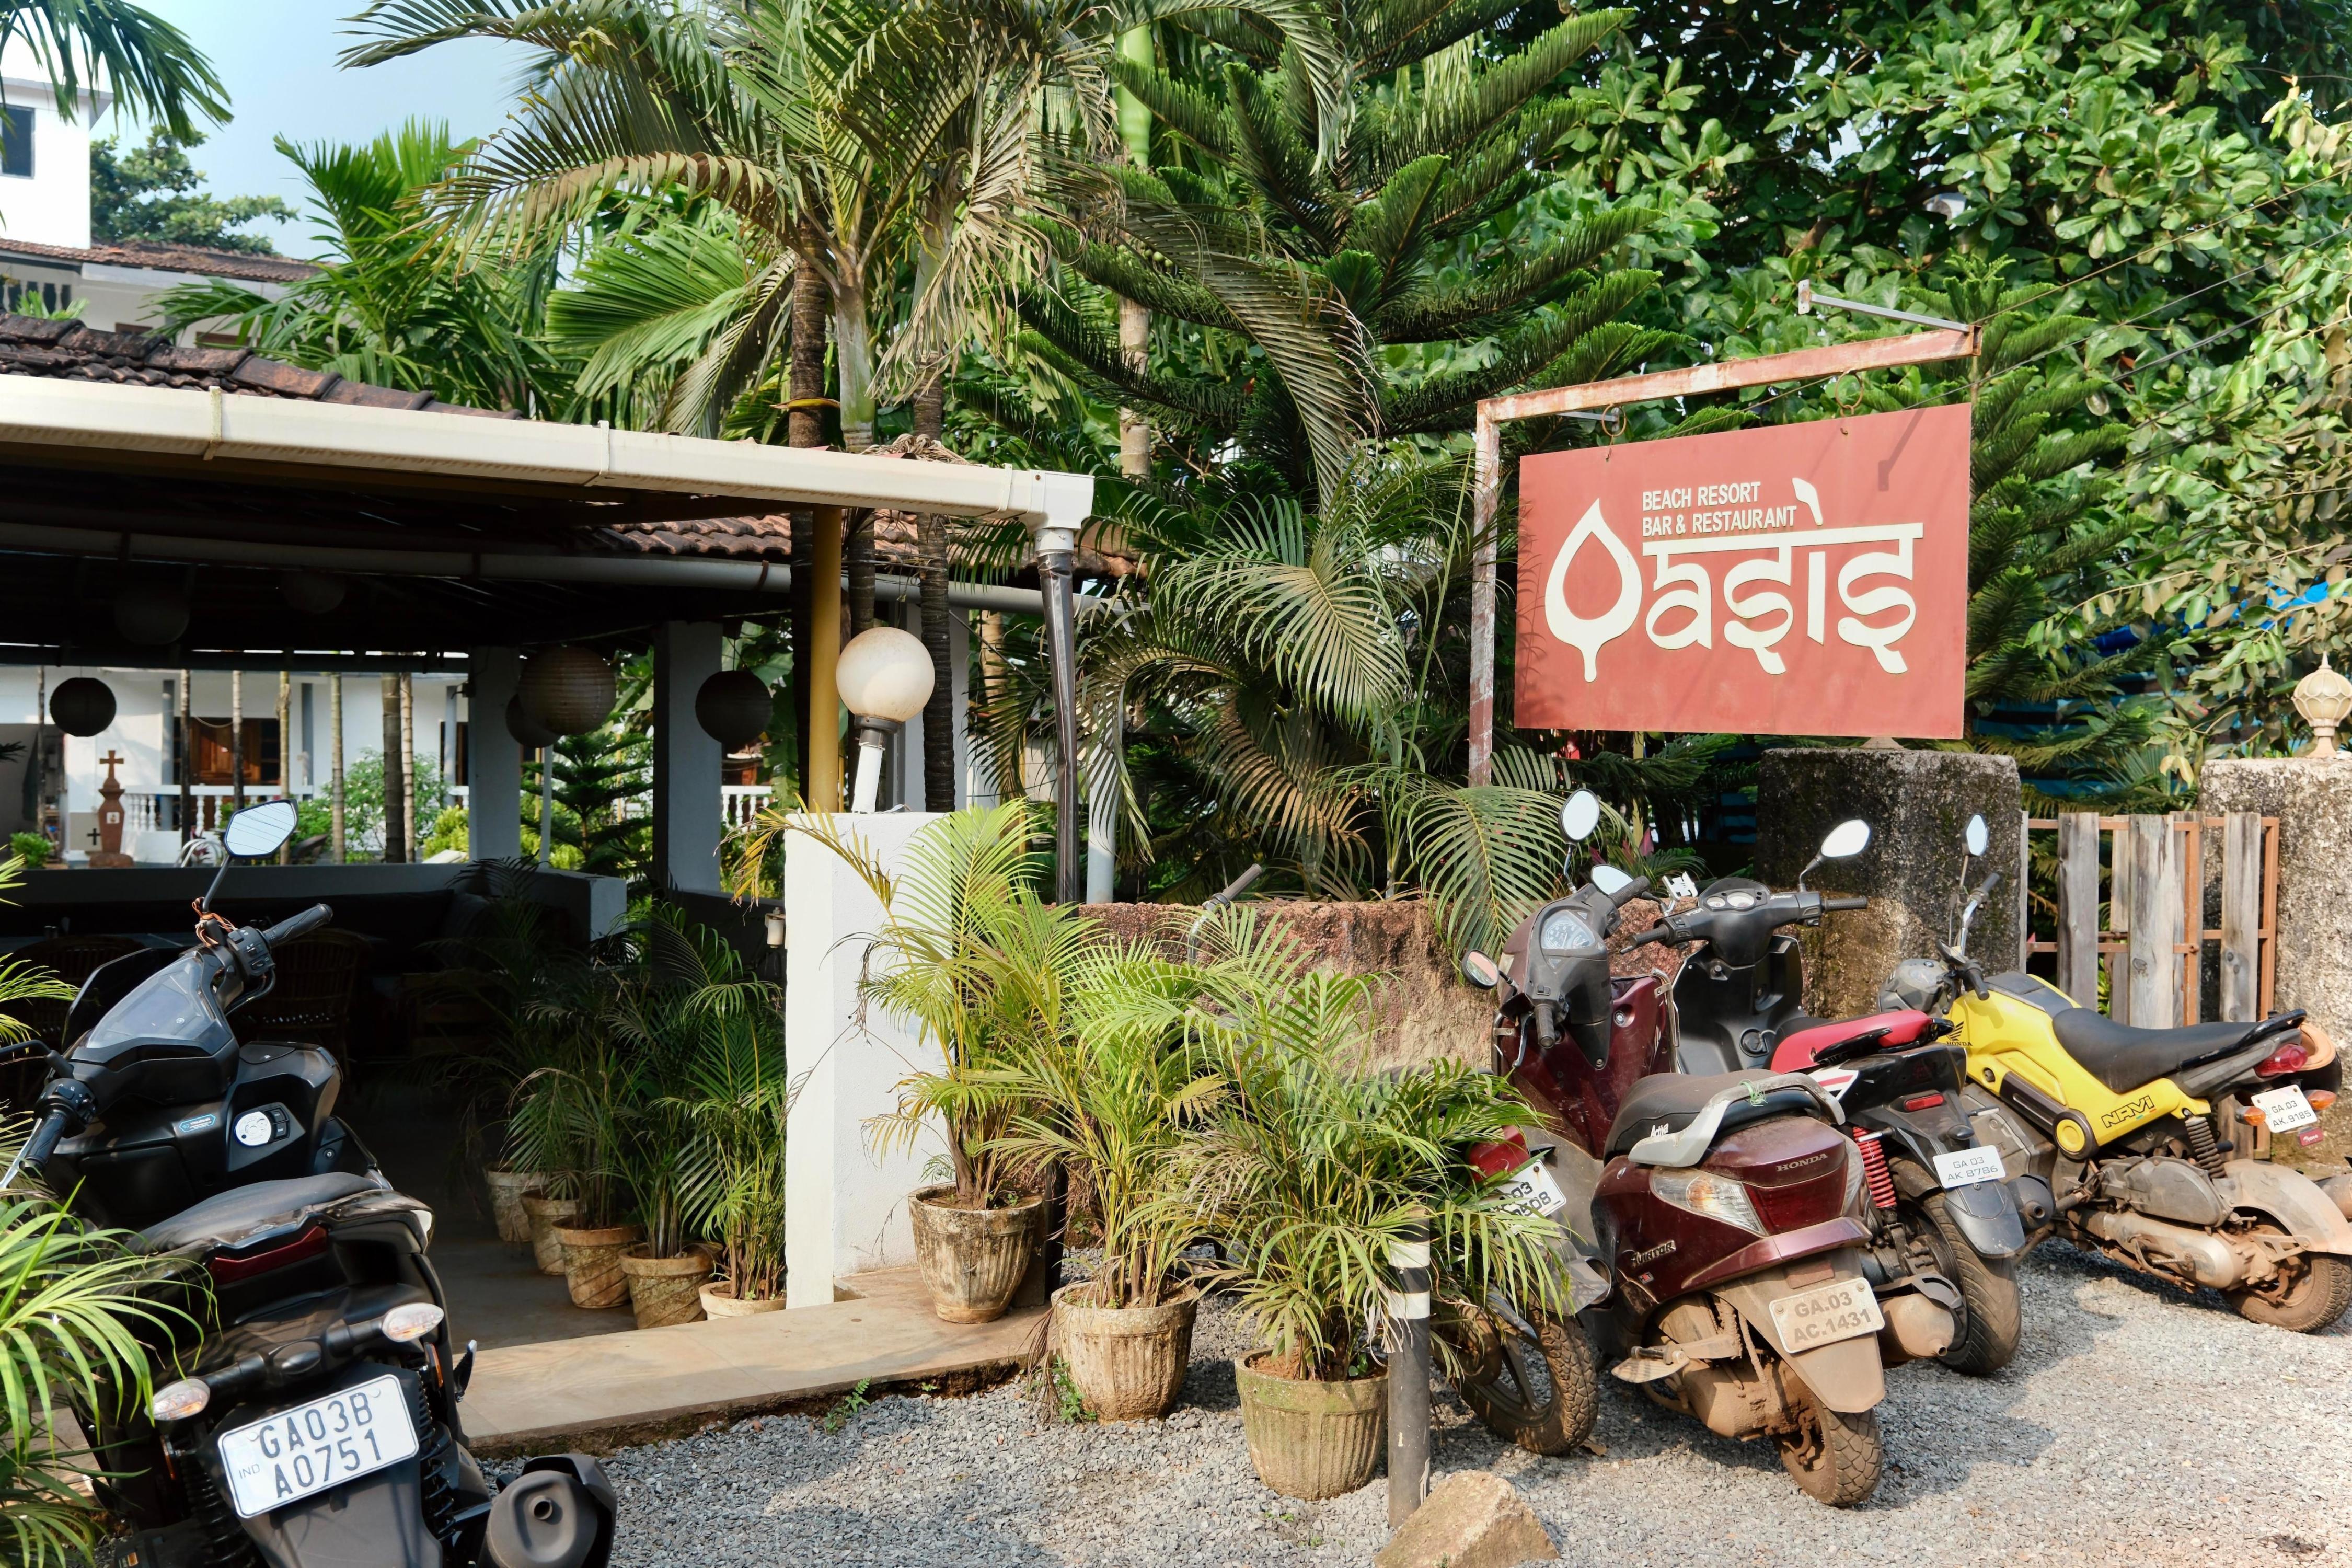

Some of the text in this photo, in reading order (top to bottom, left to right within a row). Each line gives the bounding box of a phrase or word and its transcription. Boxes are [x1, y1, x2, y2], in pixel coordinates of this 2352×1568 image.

[1643, 481, 1760, 511] BEACH RESORT
[1643, 505, 1797, 537] BAR & RESTAURANT
[1776, 1153, 1828, 1171] HONDA
[1947, 1165, 1998, 1181] AK 8786
[1953, 1157, 1985, 1169] GA 03
[1794, 1292, 1852, 1317] GA.03
[1794, 1309, 1871, 1343] AC.1431
[260, 1392, 372, 1458] GA03B
[238, 1463, 260, 1479] IND
[274, 1429, 381, 1498] A0751
